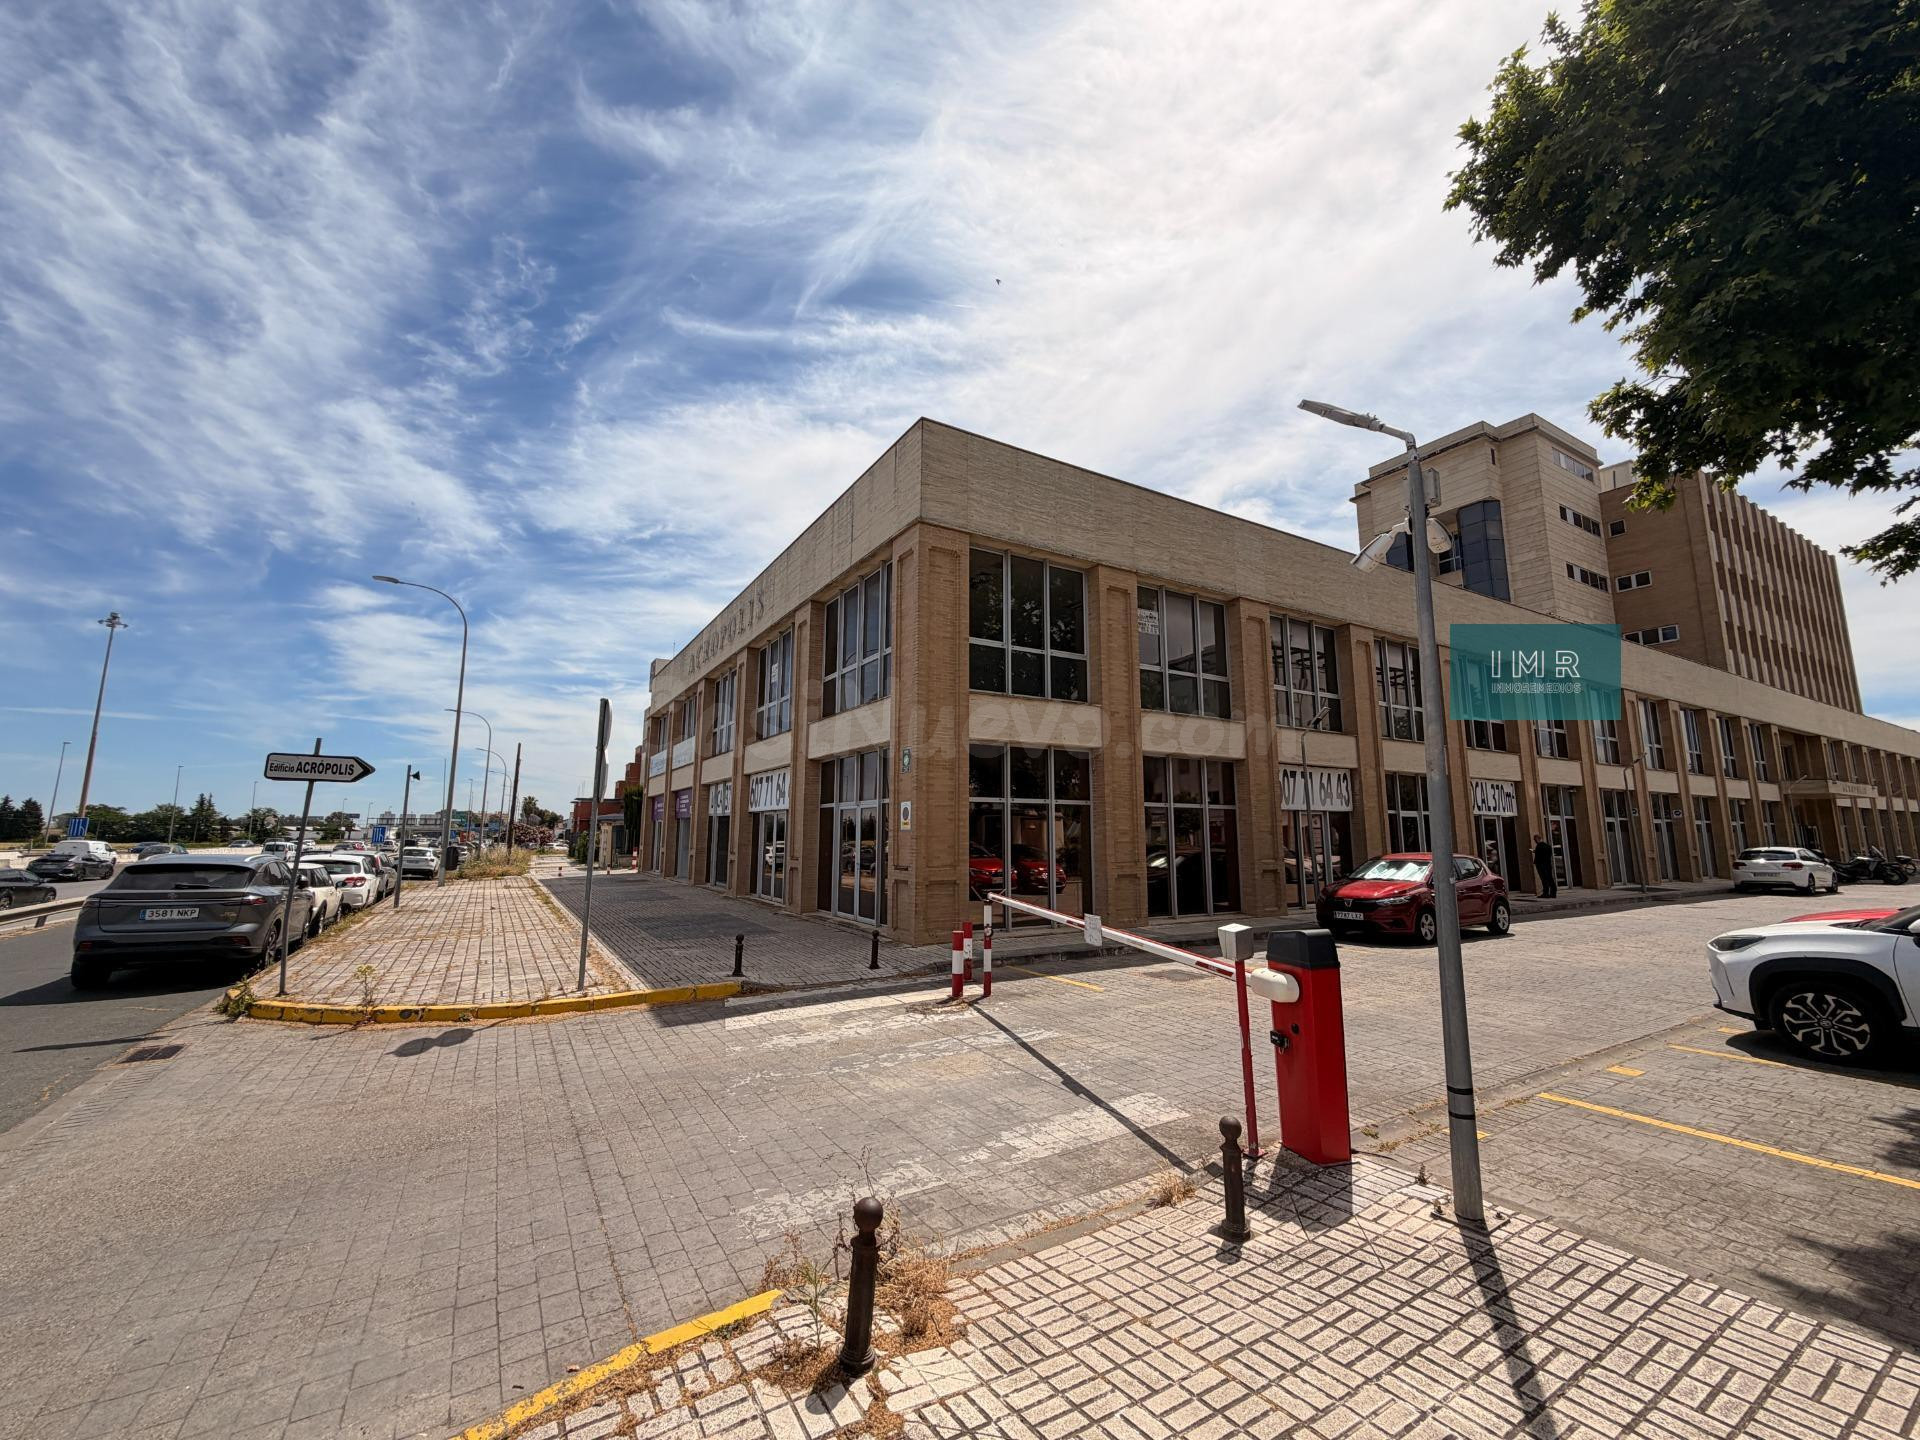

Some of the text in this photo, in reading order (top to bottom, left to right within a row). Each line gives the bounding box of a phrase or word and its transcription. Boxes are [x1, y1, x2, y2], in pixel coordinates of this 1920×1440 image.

[269, 760, 355, 776] Edificio ACRÓPOLIS
[750, 776, 764, 809] 607
[764, 774, 774, 807] 71
[1319, 772, 1334, 807] 64
[1336, 772, 1350, 808] 43
[148, 909, 197, 918] 3581 NKP
